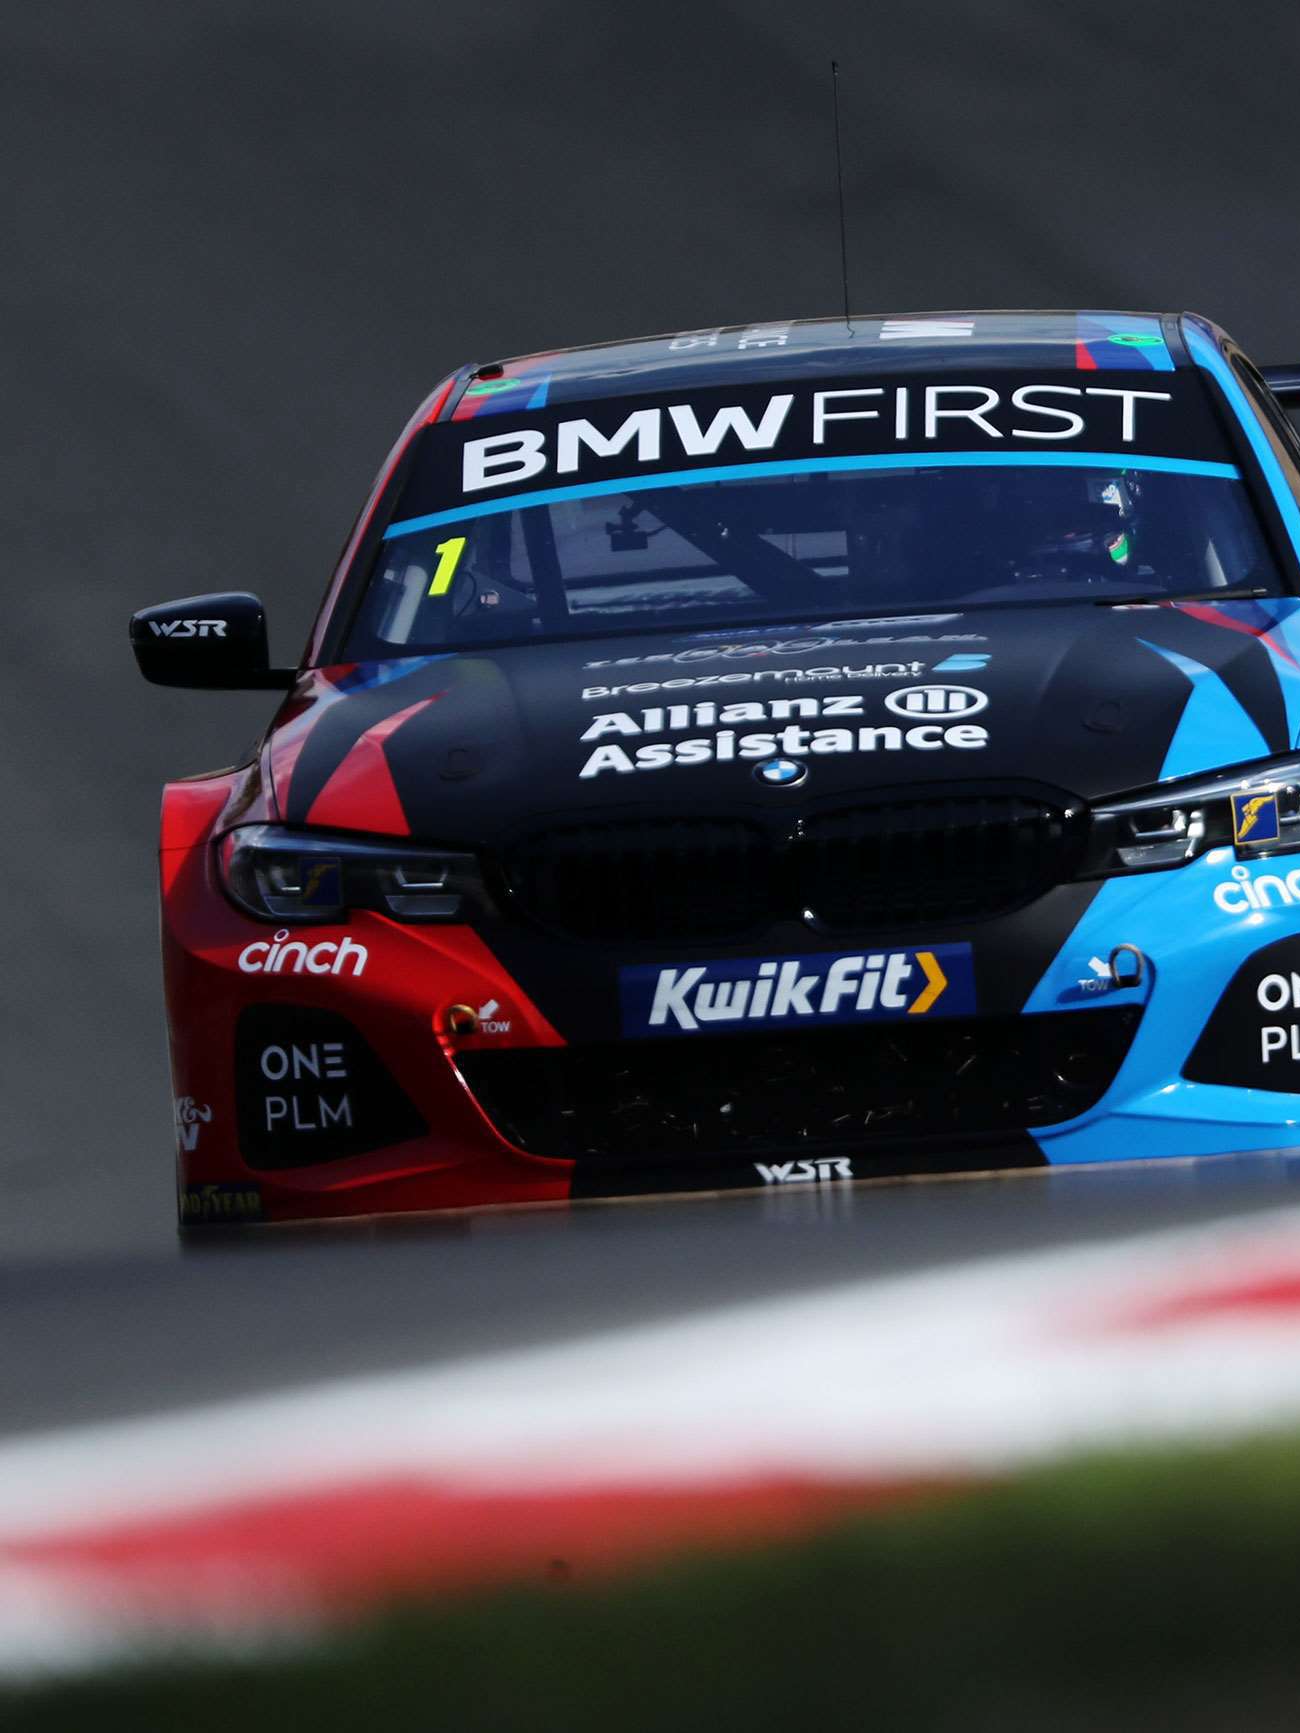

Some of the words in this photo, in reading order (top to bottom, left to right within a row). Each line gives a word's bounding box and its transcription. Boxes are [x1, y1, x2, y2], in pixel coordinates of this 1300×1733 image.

[428, 535, 466, 597] 1
[148, 618, 229, 638] WSR
[580, 659, 927, 700] Breezemount
[579, 694, 865, 743] Allianz
[579, 723, 989, 779] Assistance
[237, 928, 369, 977] cinch
[1077, 979, 1109, 992] TOW
[480, 1020, 511, 1034] TOW
[260, 1042, 348, 1081] ONE
[265, 1095, 354, 1132] PLM
[753, 1157, 855, 1185] WSR
